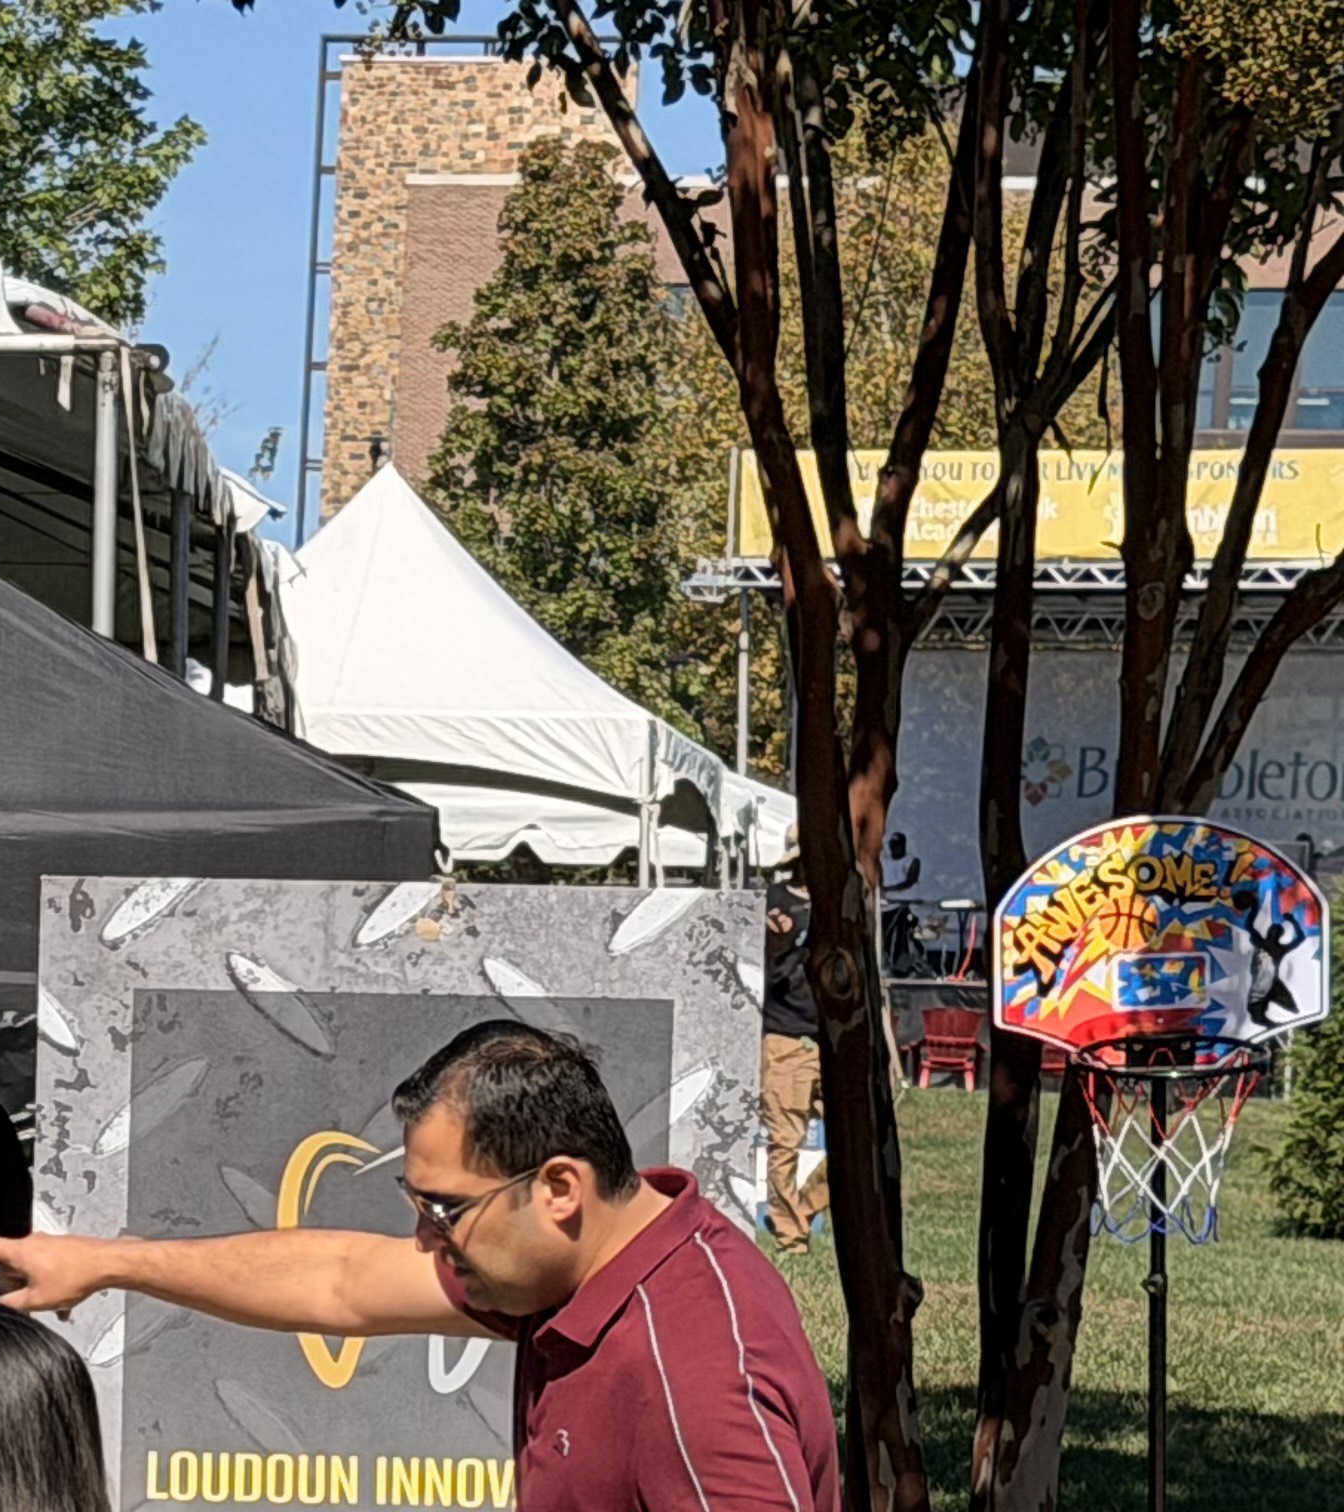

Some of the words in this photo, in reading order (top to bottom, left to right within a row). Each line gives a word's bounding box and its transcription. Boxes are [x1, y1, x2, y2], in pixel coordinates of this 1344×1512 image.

[970, 461, 996, 482] TO
[1189, 460, 1300, 481] PONRS
[146, 1450, 359, 1505] LOUDOUN
[375, 1455, 517, 1509] INNOV
